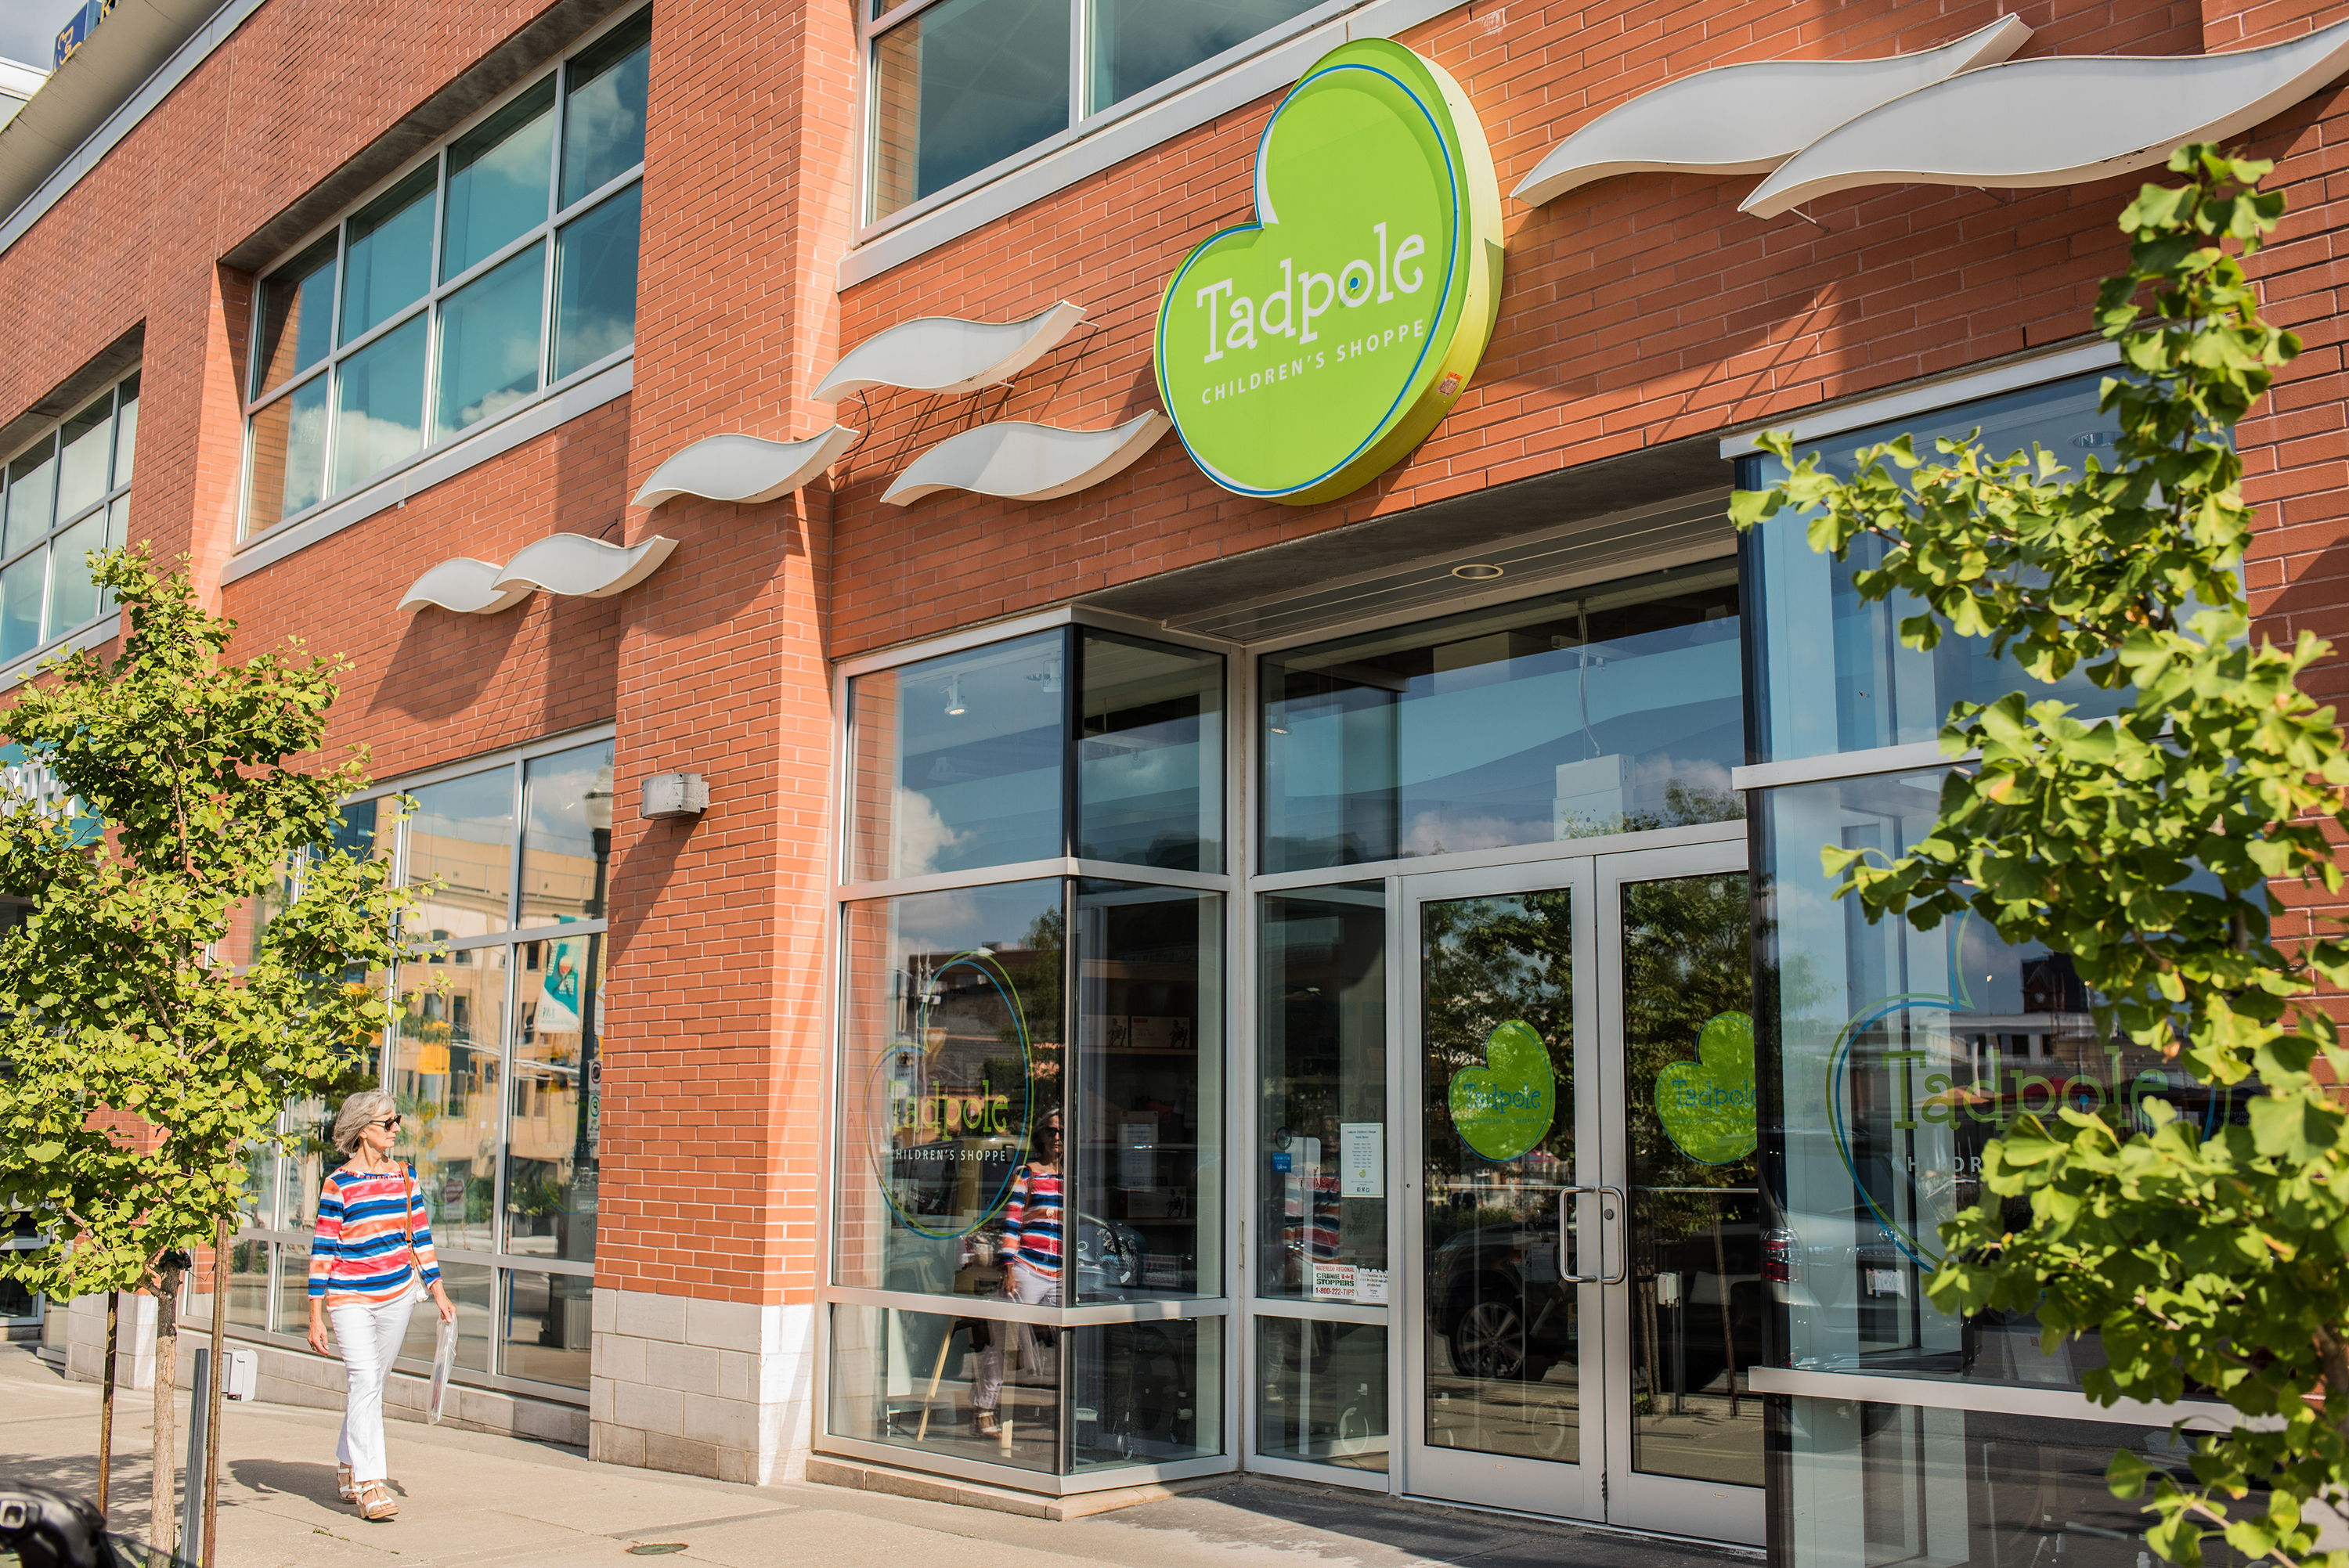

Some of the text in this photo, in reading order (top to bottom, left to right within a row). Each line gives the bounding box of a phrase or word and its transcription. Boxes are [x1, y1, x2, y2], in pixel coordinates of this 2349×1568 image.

[1196, 222, 1425, 364] Tadpole
[1201, 319, 1424, 405] CHILDREN'S SHOPPE
[888, 1080, 1009, 1141] Tadpole
[1463, 1082, 1541, 1114] Tadpole
[1882, 1046, 2169, 1131] Tadpole
[891, 1148, 1006, 1162] HILDREN'S SHOPPE
[1315, 1286, 1355, 1296] 1-800-222-TIPS
